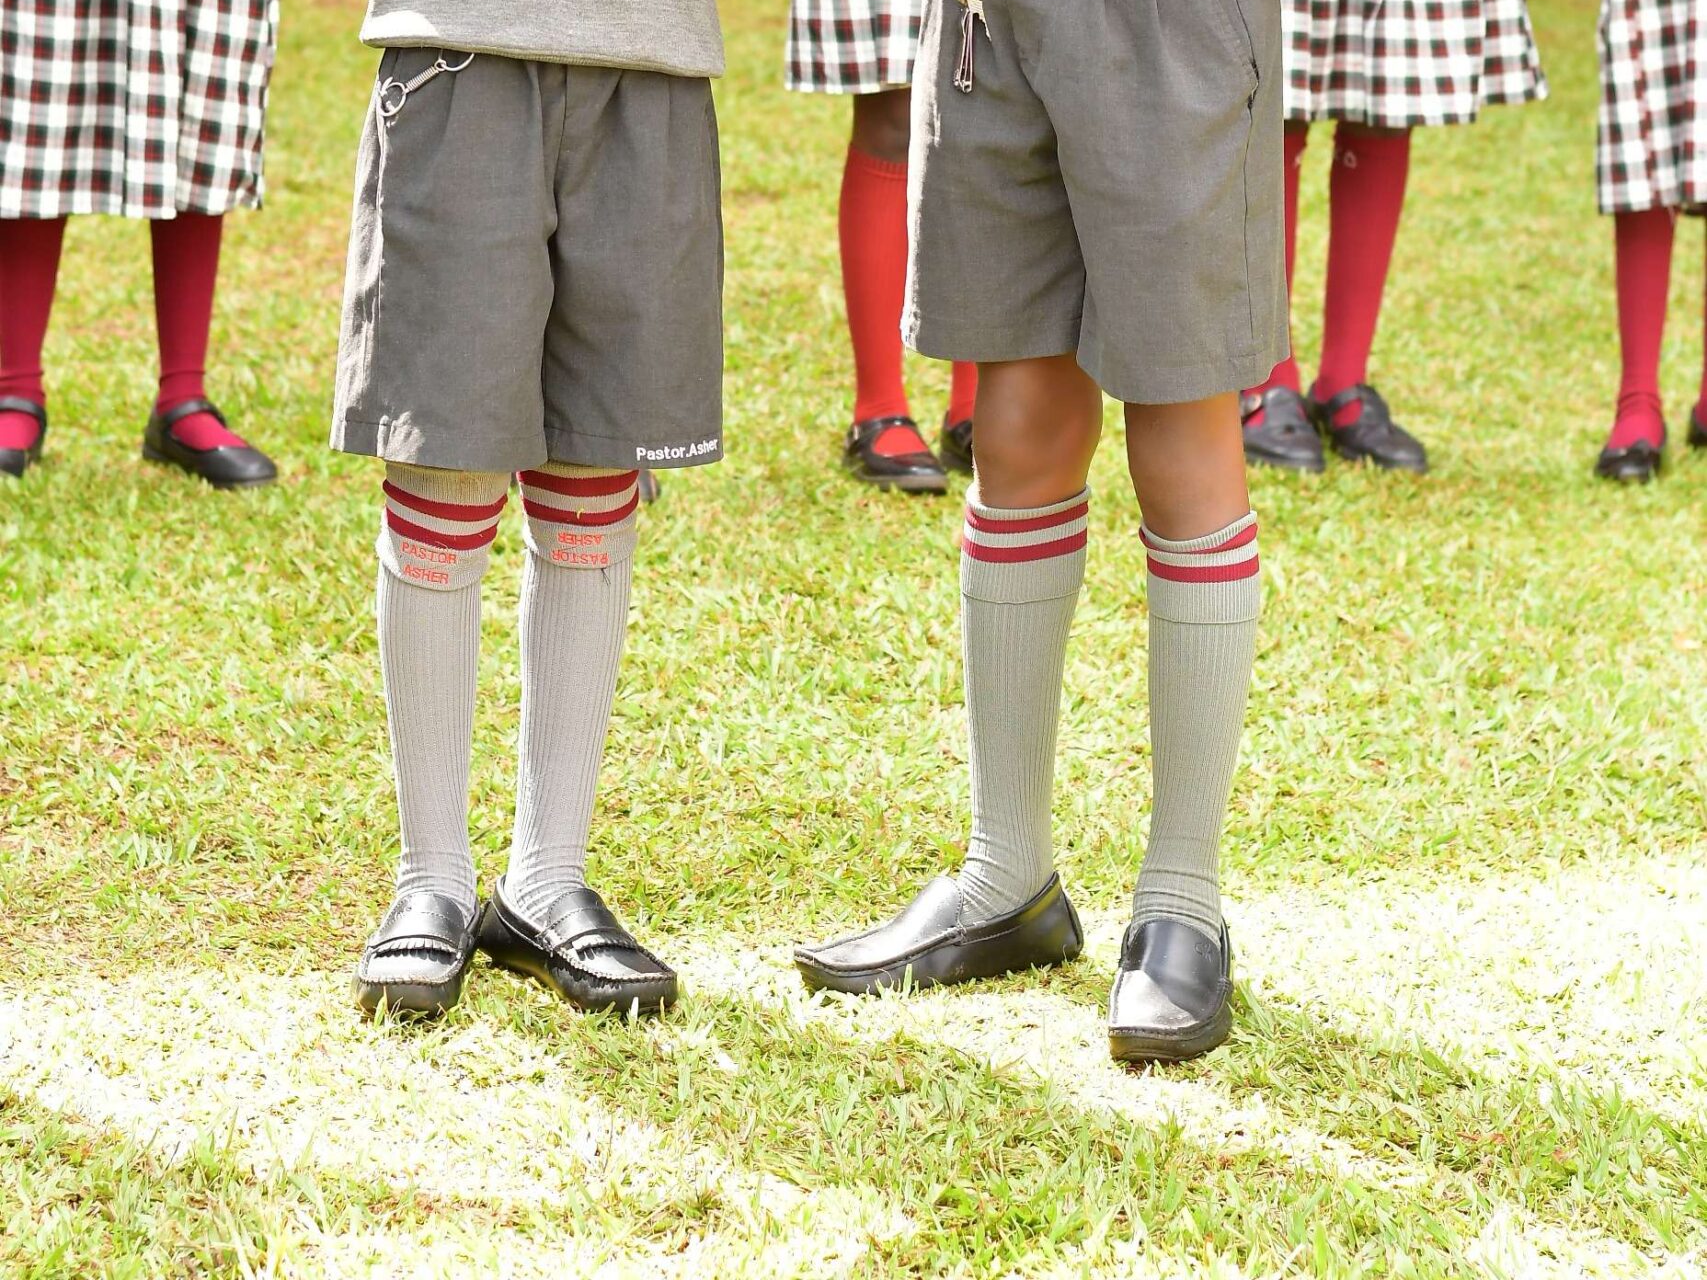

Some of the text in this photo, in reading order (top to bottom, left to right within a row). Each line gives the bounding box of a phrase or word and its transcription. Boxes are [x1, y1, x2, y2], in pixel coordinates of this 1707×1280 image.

[636, 439, 718, 461] Pastor.Asher
[558, 532, 603, 545] ASHER
[401, 541, 457, 564] PASTOR
[403, 564, 448, 584] ASHER
